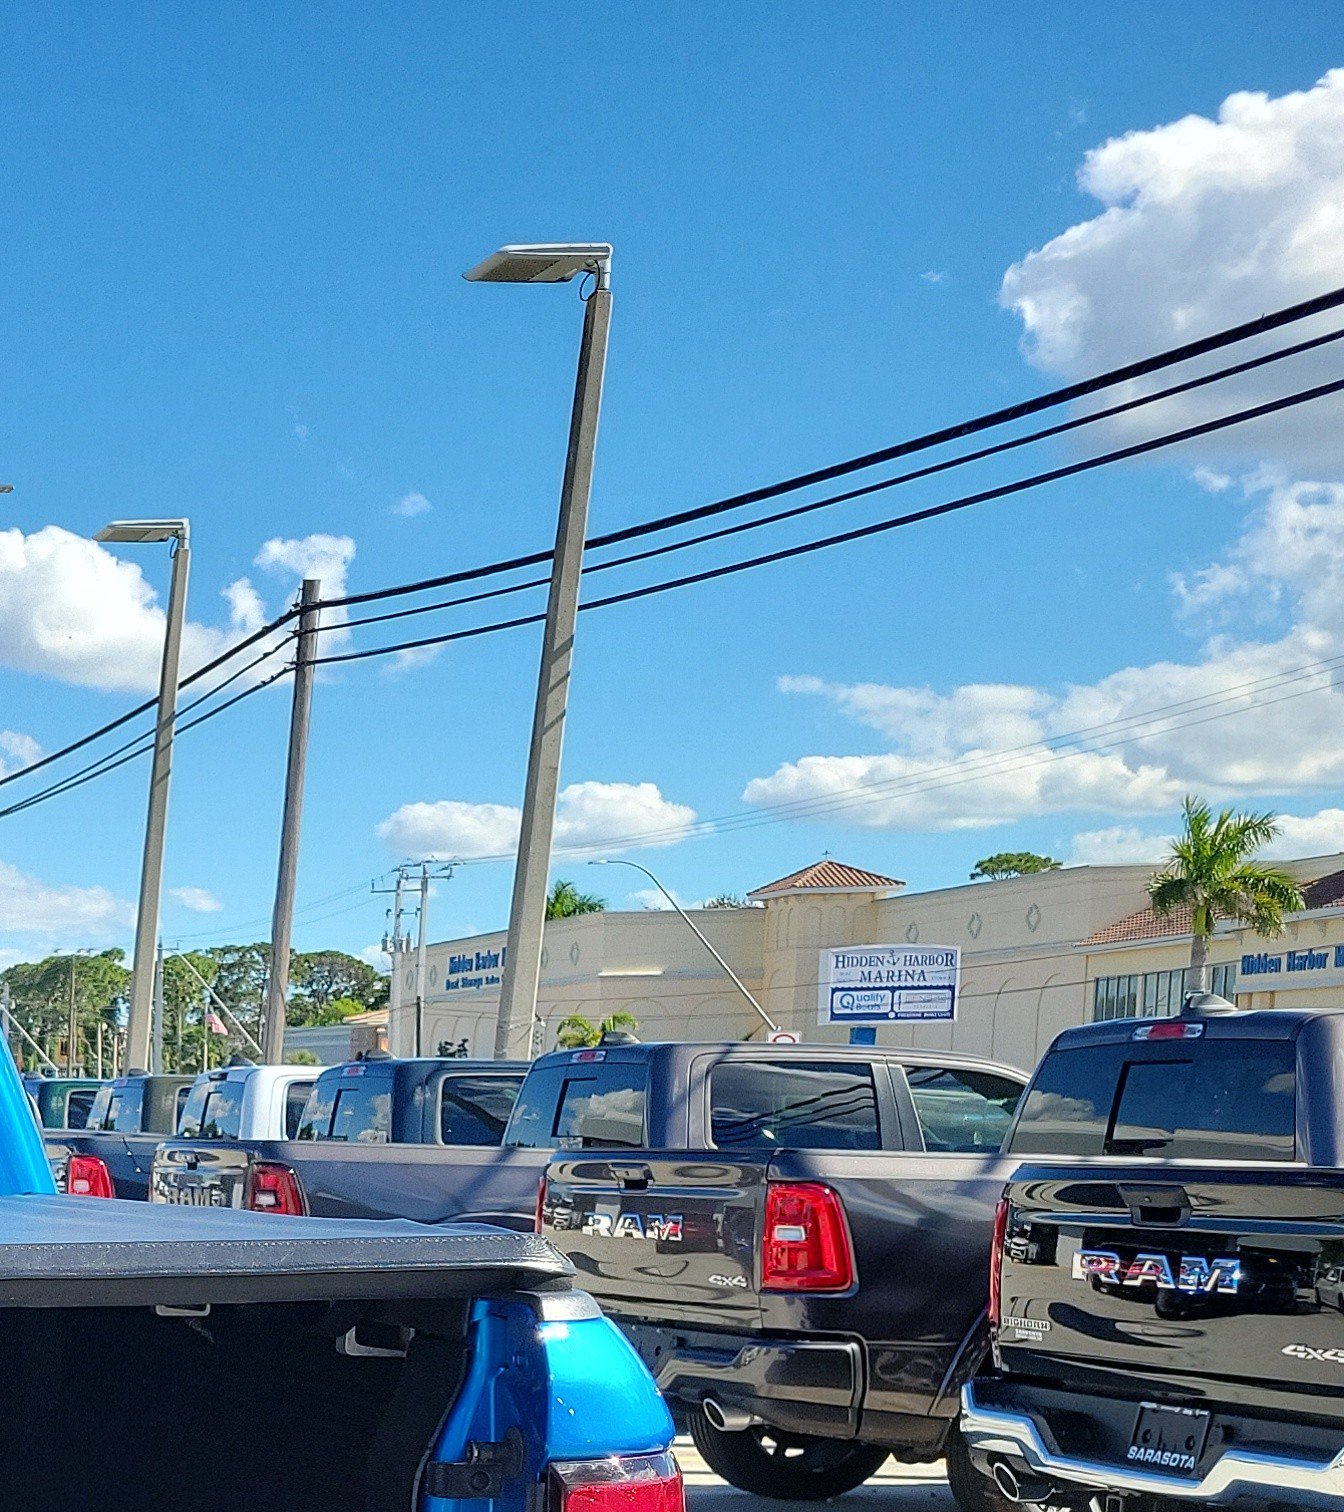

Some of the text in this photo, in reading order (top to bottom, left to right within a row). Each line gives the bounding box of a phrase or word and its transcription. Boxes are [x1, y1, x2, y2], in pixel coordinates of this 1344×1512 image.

[859, 969, 928, 983] MARINA
[582, 1212, 684, 1242] RAM
[1071, 1249, 1240, 1294] RAM
[1127, 1445, 1196, 1470] SARASOTA
